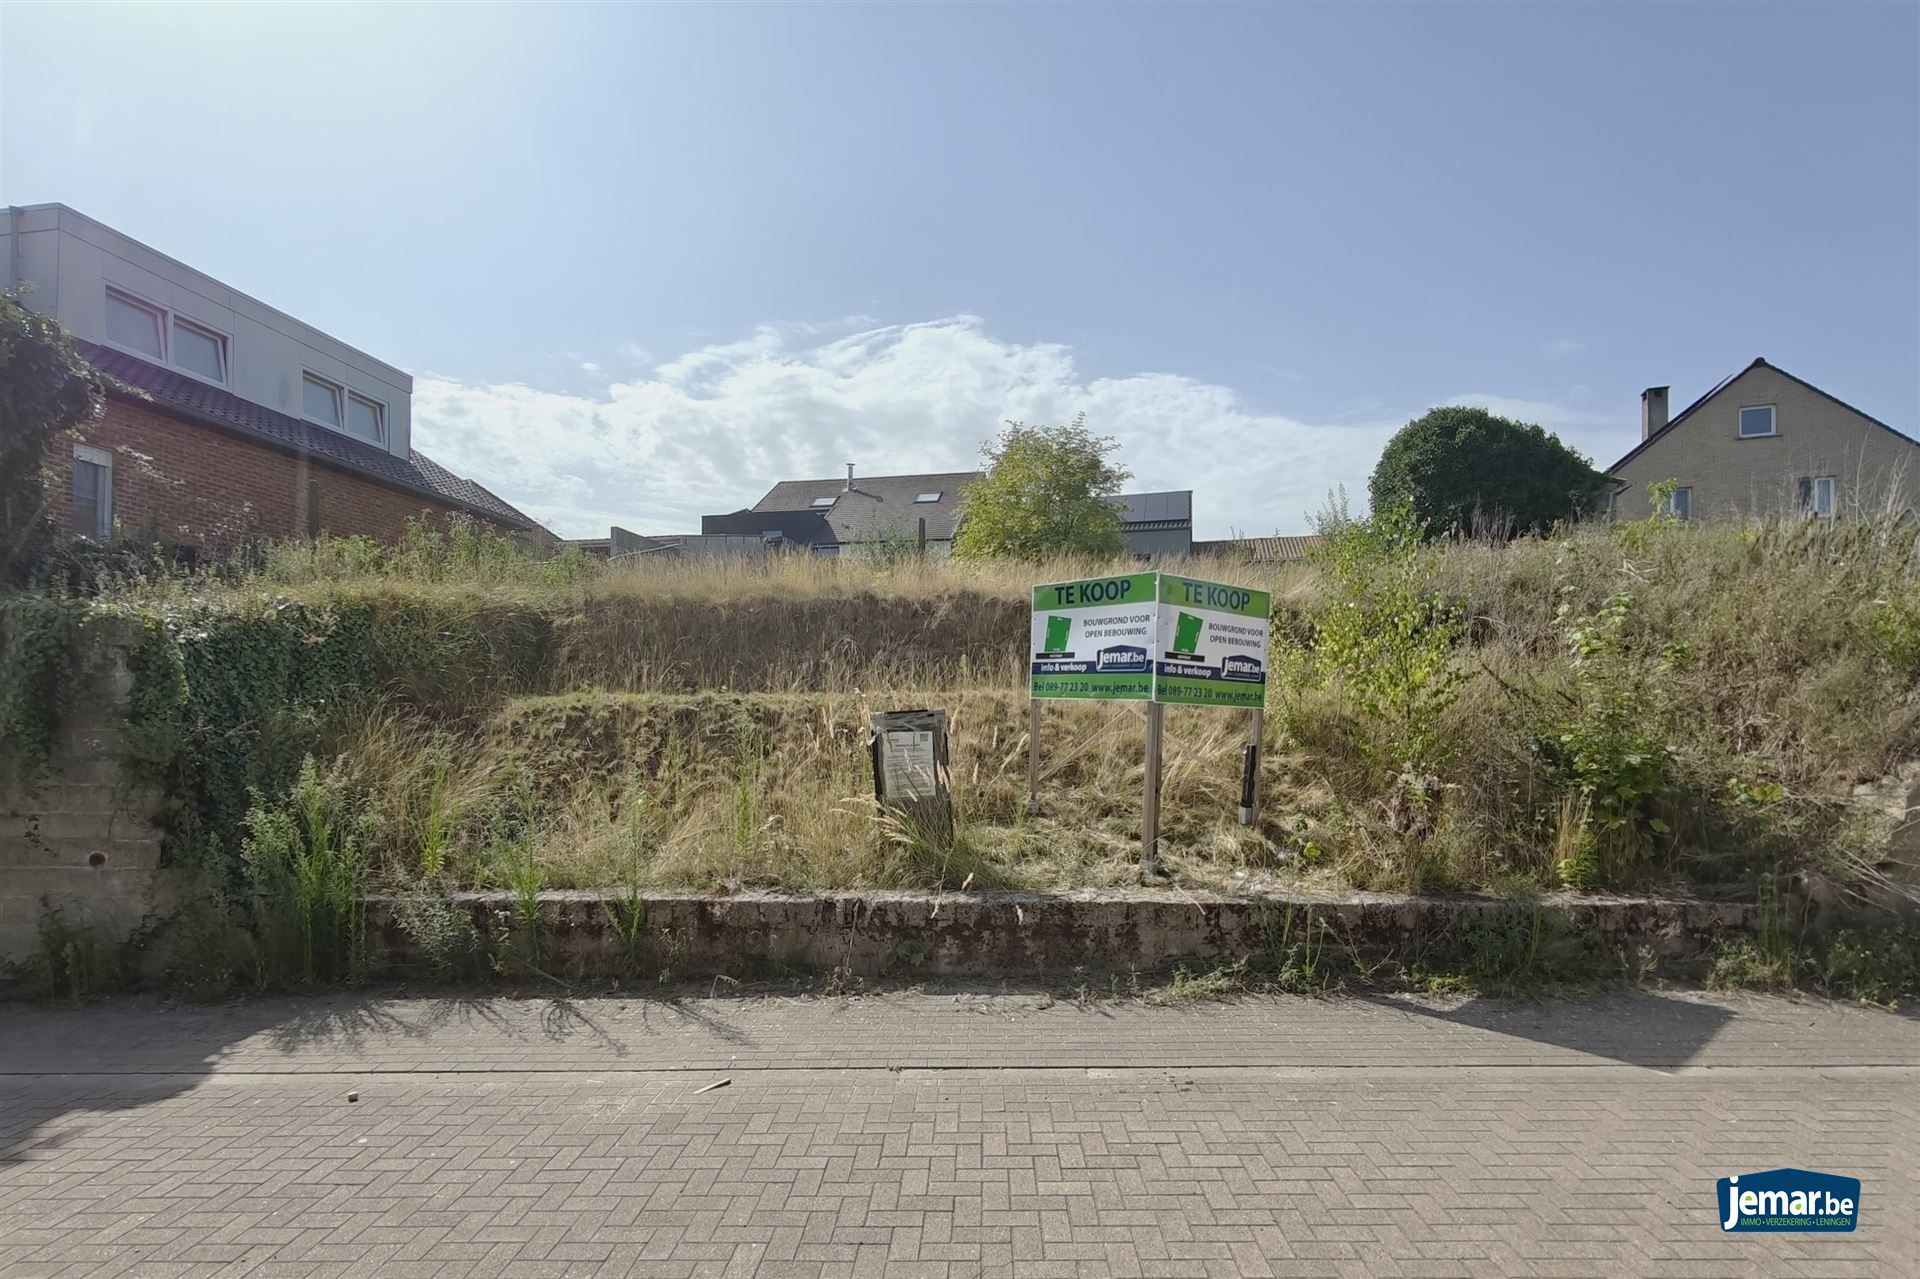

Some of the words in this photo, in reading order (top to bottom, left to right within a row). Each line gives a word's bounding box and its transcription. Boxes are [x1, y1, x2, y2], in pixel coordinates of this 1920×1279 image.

[1055, 586, 1074, 604] TE
[1080, 580, 1131, 603] KOOP
[1183, 582, 1202, 604] TE
[1208, 586, 1250, 610] KOOP
[1083, 616, 1128, 627] BOUWGROND
[1129, 614, 1150, 624] VOOR
[1084, 630, 1103, 638] OPEN
[1104, 627, 1147, 638] BEBOUWING
[1208, 623, 1246, 636] BOUWGROND
[1248, 628, 1264, 637] VOOR
[1210, 635, 1227, 644] OPEN
[1228, 637, 1261, 648] BEBOUWING
[1040, 663, 1054, 672] info
[1055, 663, 1060, 672] &
[1061, 662, 1087, 672] verkoop
[1097, 650, 1144, 670] jemar.be
[1222, 656, 1260, 678] jemar.be
[1164, 664, 1176, 674] info
[1177, 666, 1183, 674] &
[1184, 666, 1212, 678] verkoop
[1034, 682, 1044, 692] Bel
[1045, 682, 1068, 692] 089-77
[1070, 682, 1078, 691] 23
[1079, 682, 1088, 691] 20
[1091, 682, 1149, 694] www.jemar.be
[1157, 684, 1167, 695] Bel
[1168, 686, 1192, 697] 089-77
[1194, 688, 1203, 697] 23
[1204, 688, 1212, 698] 20
[1215, 690, 1262, 702] www.jemar.be
